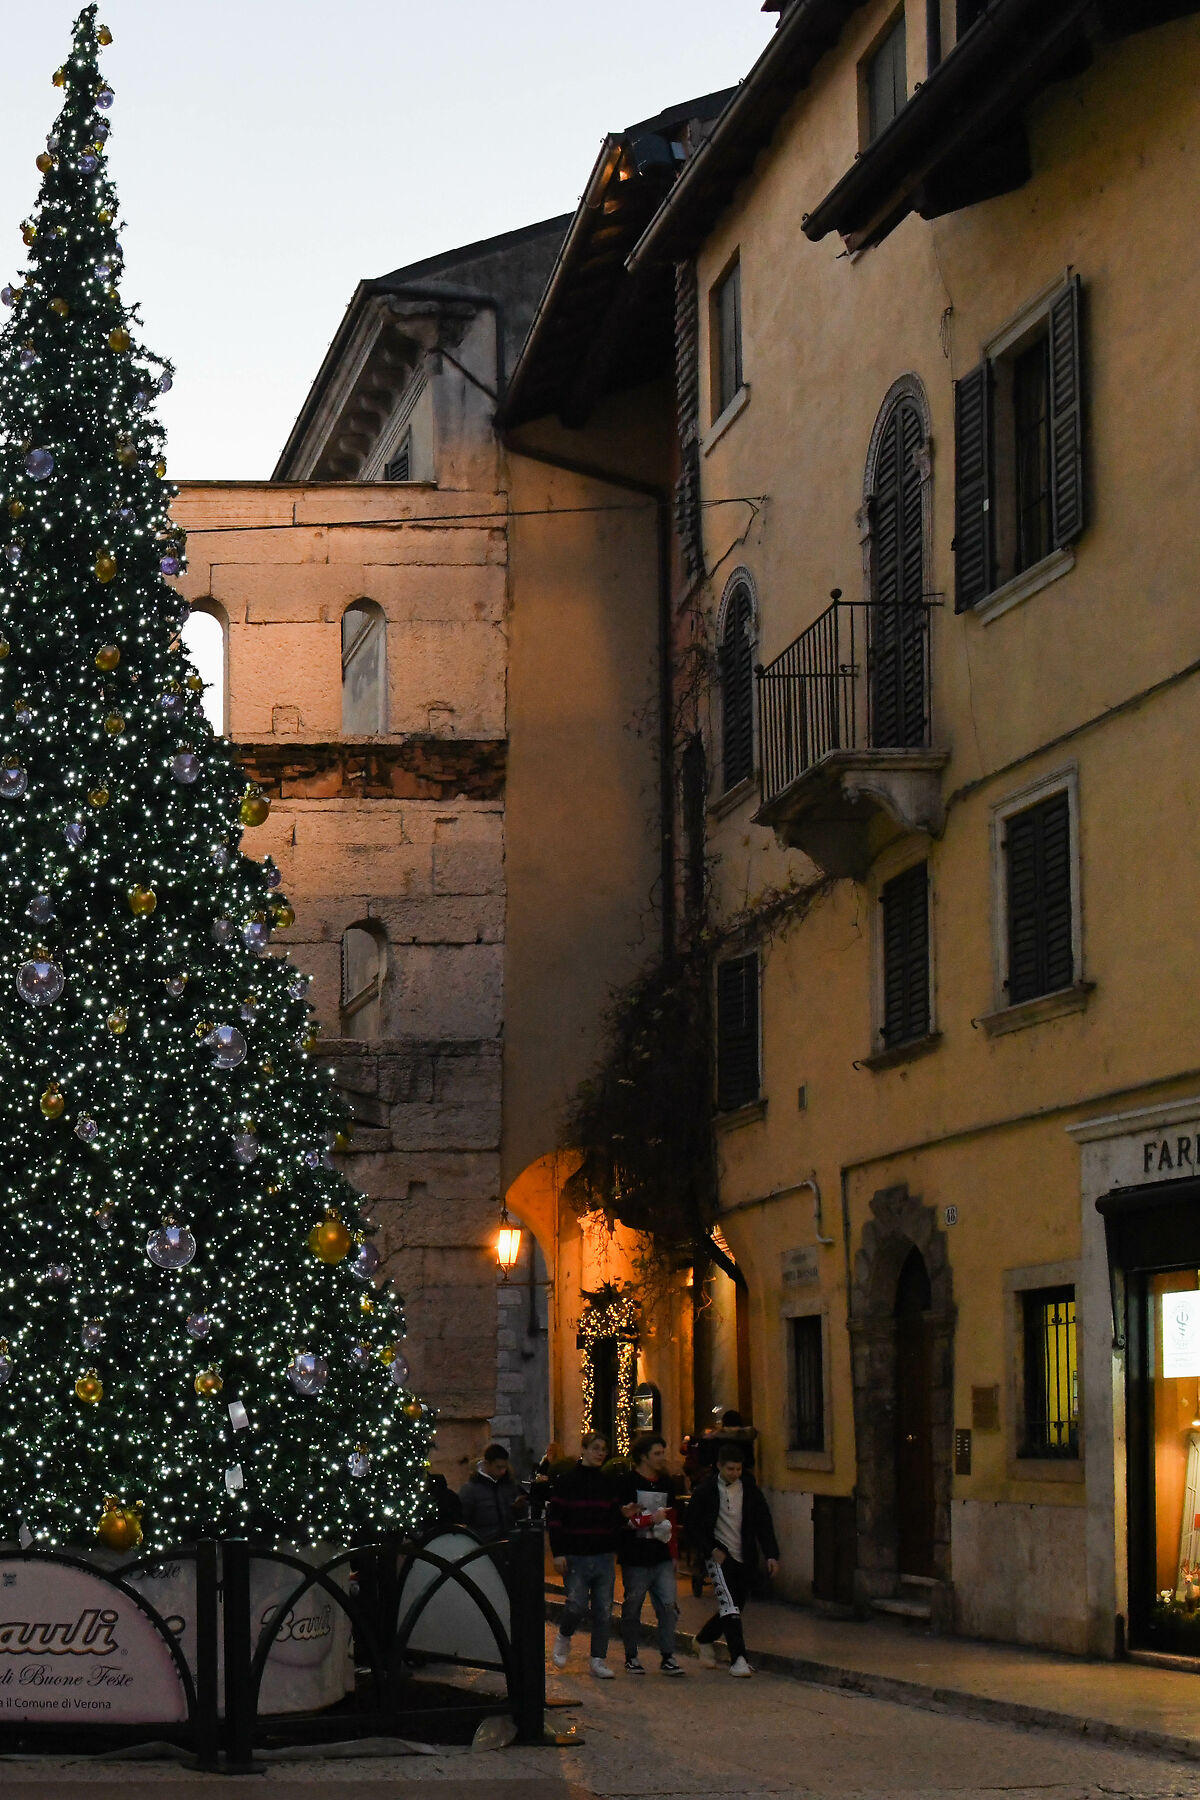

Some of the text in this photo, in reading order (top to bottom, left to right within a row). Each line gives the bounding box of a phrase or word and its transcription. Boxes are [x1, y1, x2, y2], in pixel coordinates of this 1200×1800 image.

[19, 1662, 83, 1687] Buone
[86, 1664, 135, 1687] Feste
[6, 1697, 13, 1708] il
[14, 1697, 60, 1709] Comune
[62, 1698, 73, 1709] di
[74, 1698, 112, 1710] Verona
